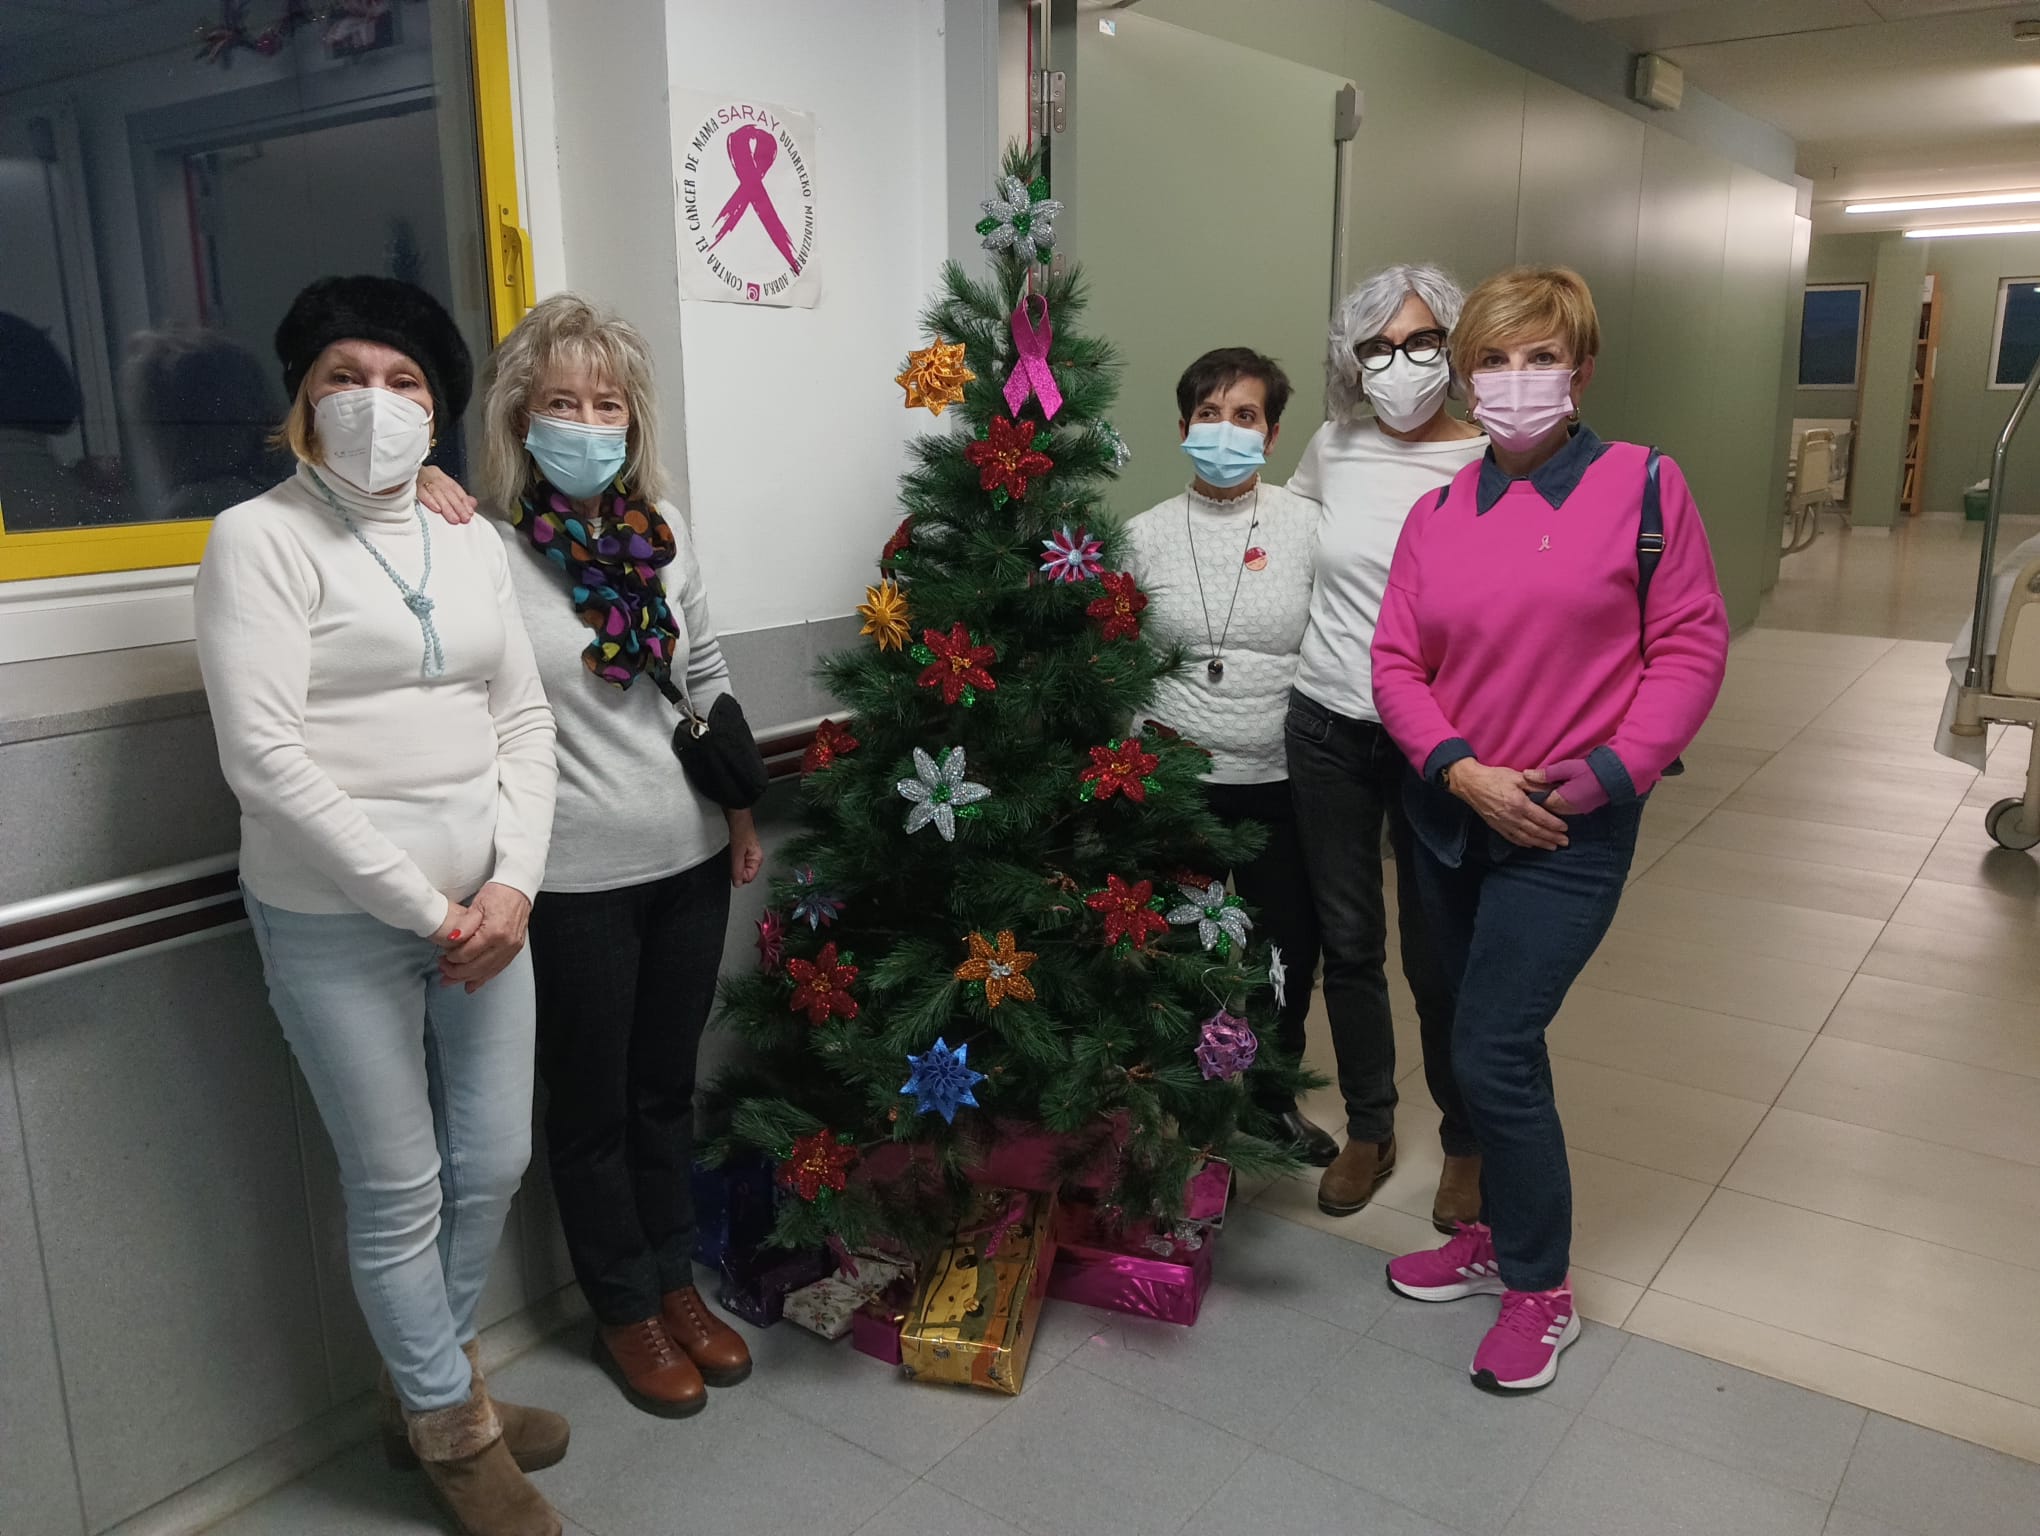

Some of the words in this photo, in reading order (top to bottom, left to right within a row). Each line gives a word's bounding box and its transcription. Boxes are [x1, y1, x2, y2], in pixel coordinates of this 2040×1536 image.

[717, 105, 780, 131] SARAY
[692, 118, 719, 152] MAMA
[684, 153, 699, 173] DE
[780, 130, 811, 197] BULARREKO
[696, 236, 709, 253] EL
[707, 253, 743, 291] CONTRA
